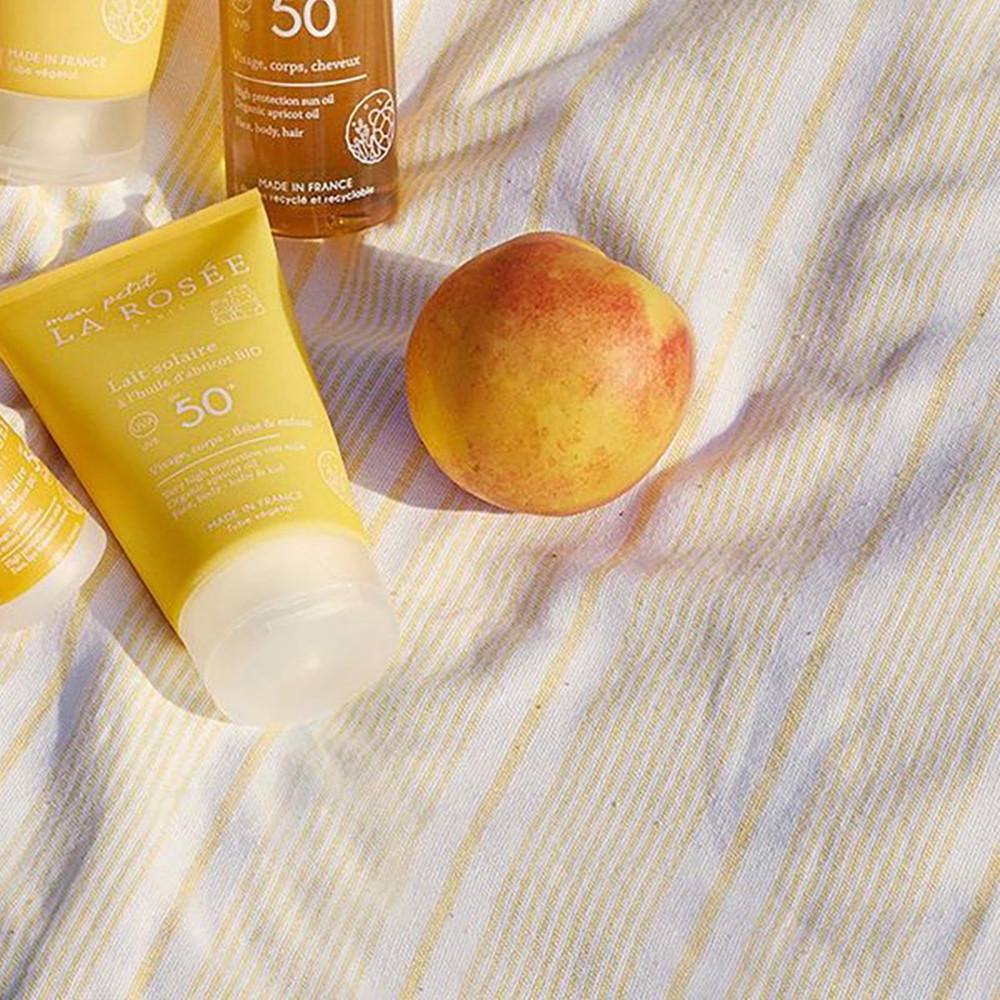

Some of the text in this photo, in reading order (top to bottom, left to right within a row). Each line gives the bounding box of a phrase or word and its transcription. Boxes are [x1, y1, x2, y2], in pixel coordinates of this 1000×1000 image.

[269, 60, 309, 75] corps,
[311, 55, 361, 72] cheveux
[322, 94, 335, 105] oil
[267, 108, 303, 120] apricot
[305, 108, 320, 119] oil
[283, 126, 305, 138] hair
[258, 178, 353, 192] MADE IN FRANCE
[310, 195, 321, 204] et
[323, 186, 376, 205] recyclable
[50, 317, 104, 347] LA
[119, 253, 250, 321] ROSÉE
[102, 272, 157, 311] petit
[235, 346, 263, 361] BIO
[108, 343, 218, 394] Lait solaire
